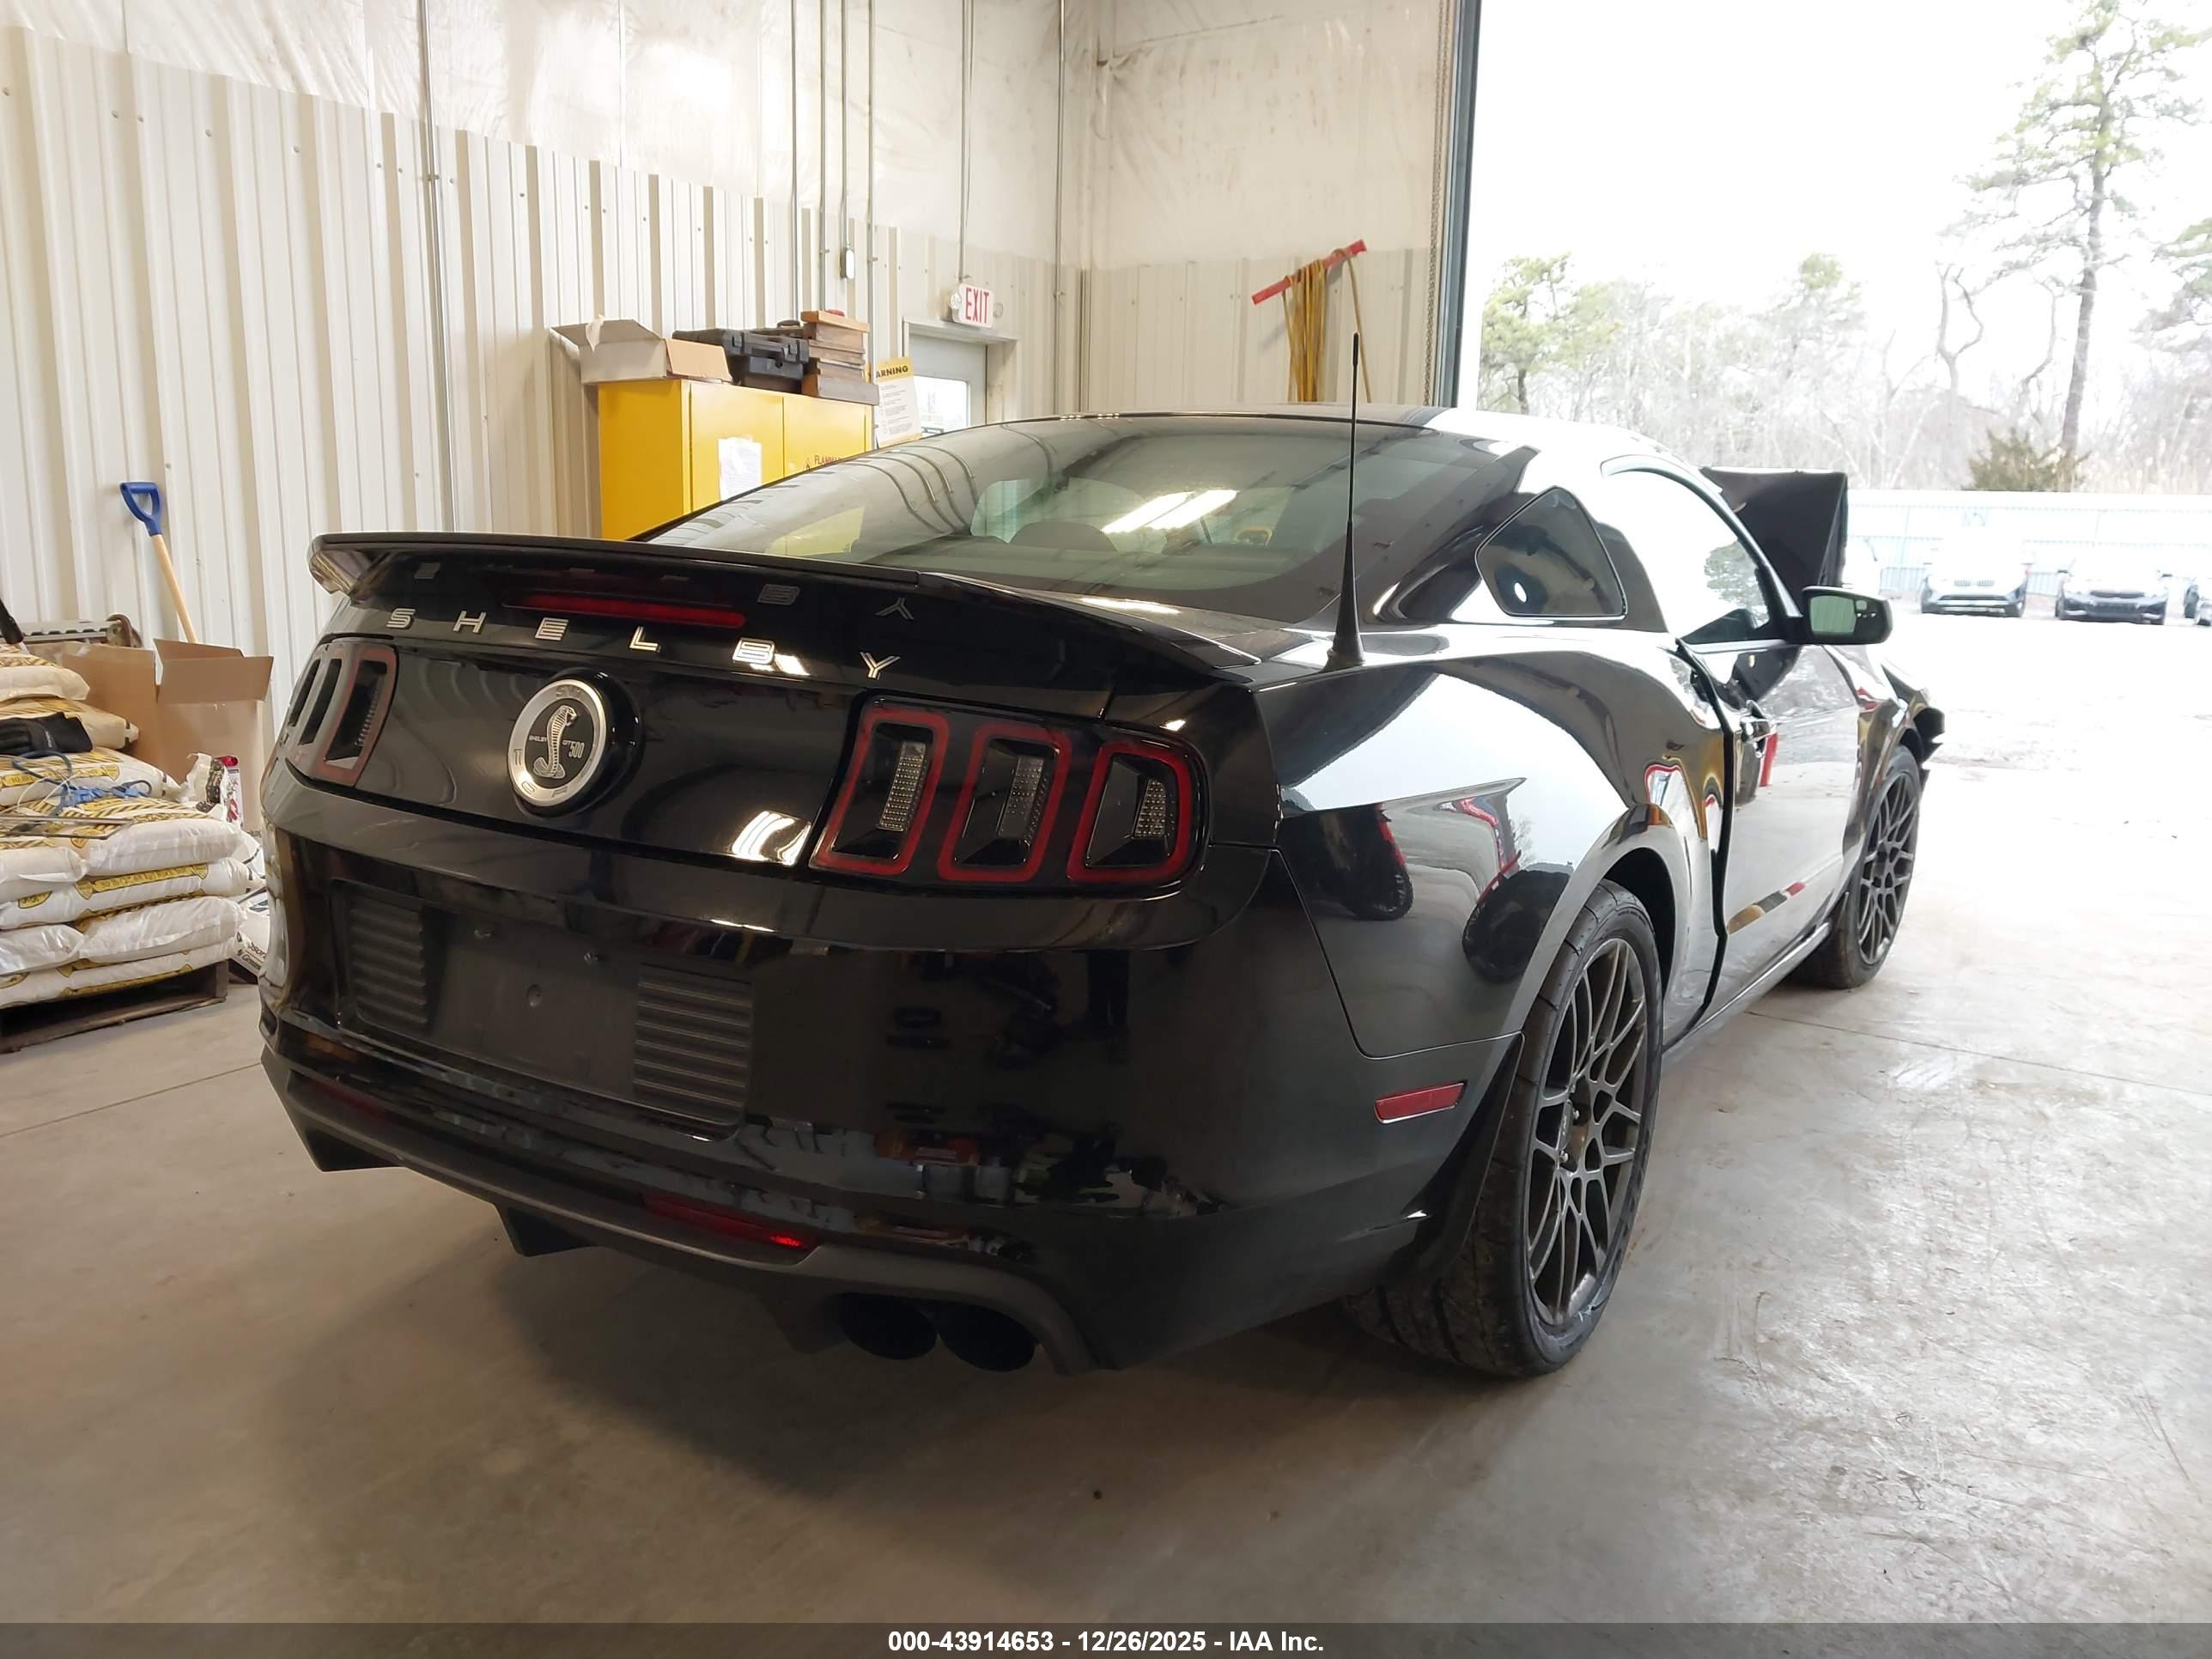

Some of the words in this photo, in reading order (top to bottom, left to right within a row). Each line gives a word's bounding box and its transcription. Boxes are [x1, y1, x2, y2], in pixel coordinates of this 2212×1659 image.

[966, 287, 989, 324] EXIT
[876, 365, 908, 379] ARNING
[386, 607, 901, 681] SHELBY
